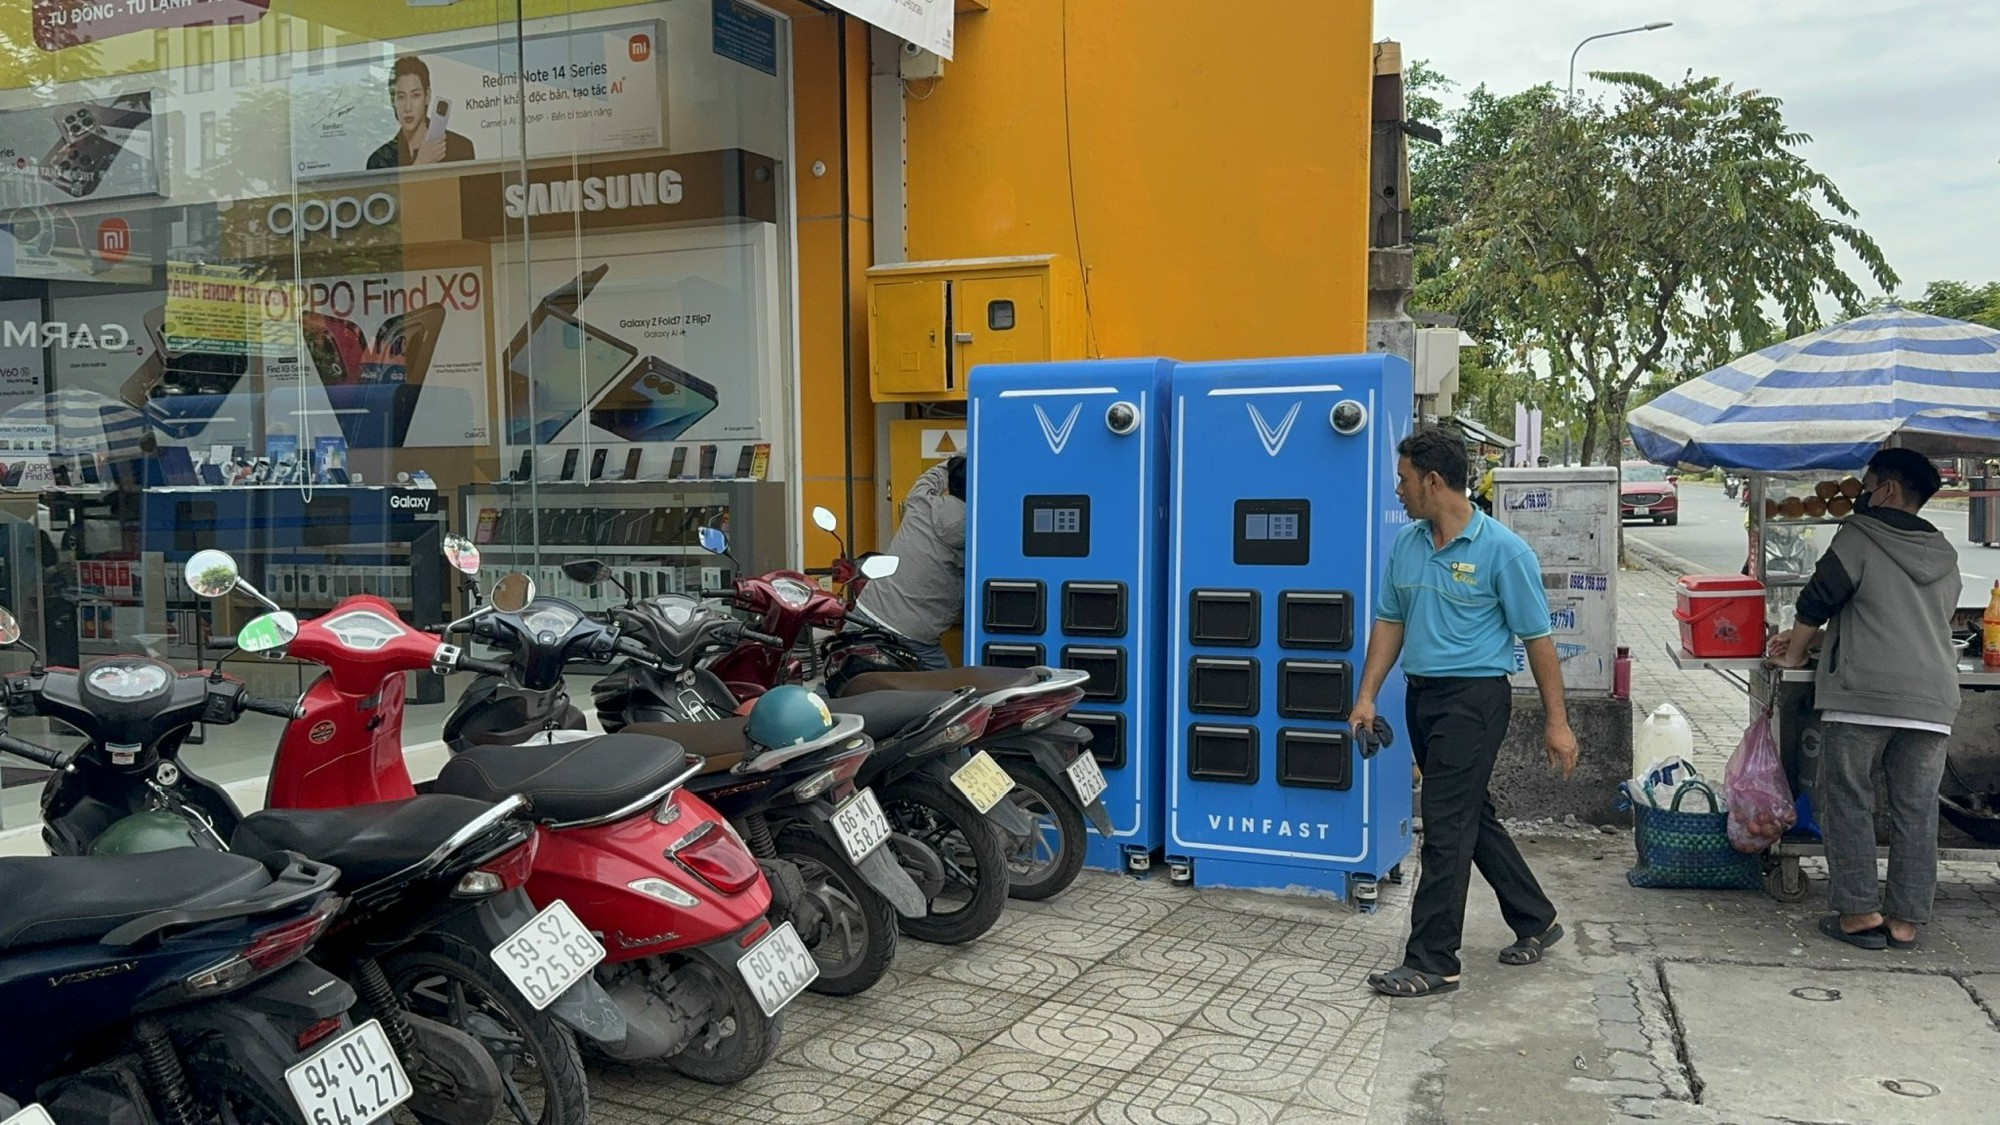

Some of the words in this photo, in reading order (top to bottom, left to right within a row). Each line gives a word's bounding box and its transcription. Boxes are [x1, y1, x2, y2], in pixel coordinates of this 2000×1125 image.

[49, 5, 67, 26] TỦ
[71, 1, 114, 24] ĐÔNG
[482, 71, 517, 88] Redmi
[521, 69, 549, 83] Note
[552, 65, 566, 80] 14
[569, 62, 608, 78] Series
[465, 96, 501, 110] Khoảnh
[528, 90, 547, 105] độc
[573, 86, 589, 100] tạo
[591, 83, 608, 96] tác
[611, 80, 623, 94] AI
[0, 147, 15, 158] ries
[505, 168, 683, 218] SAMSUNG
[264, 279, 355, 323] OPPO
[364, 277, 428, 317] Find
[436, 271, 481, 312] X9
[619, 318, 650, 330] Galaxy
[651, 317, 657, 327] Z
[658, 315, 681, 326] Fold7
[684, 314, 691, 325] Z
[692, 314, 711, 326] Flip7
[643, 329, 670, 339] Galaxy
[390, 495, 431, 511] Galaxy
[709, 778, 771, 800] VISION
[839, 795, 875, 834] 66-N1
[1208, 814, 1329, 840] VINFAST
[847, 814, 889, 859] 458.22
[505, 914, 571, 970] 59-S2
[615, 930, 682, 949] Vespa
[522, 934, 597, 1002] 625.89
[749, 934, 795, 980] 60-B4
[48, 960, 139, 987] VISION
[759, 953, 812, 1007] 418.42
[304, 1034, 376, 1099] 94-D1
[313, 1062, 398, 1125] 644.27
